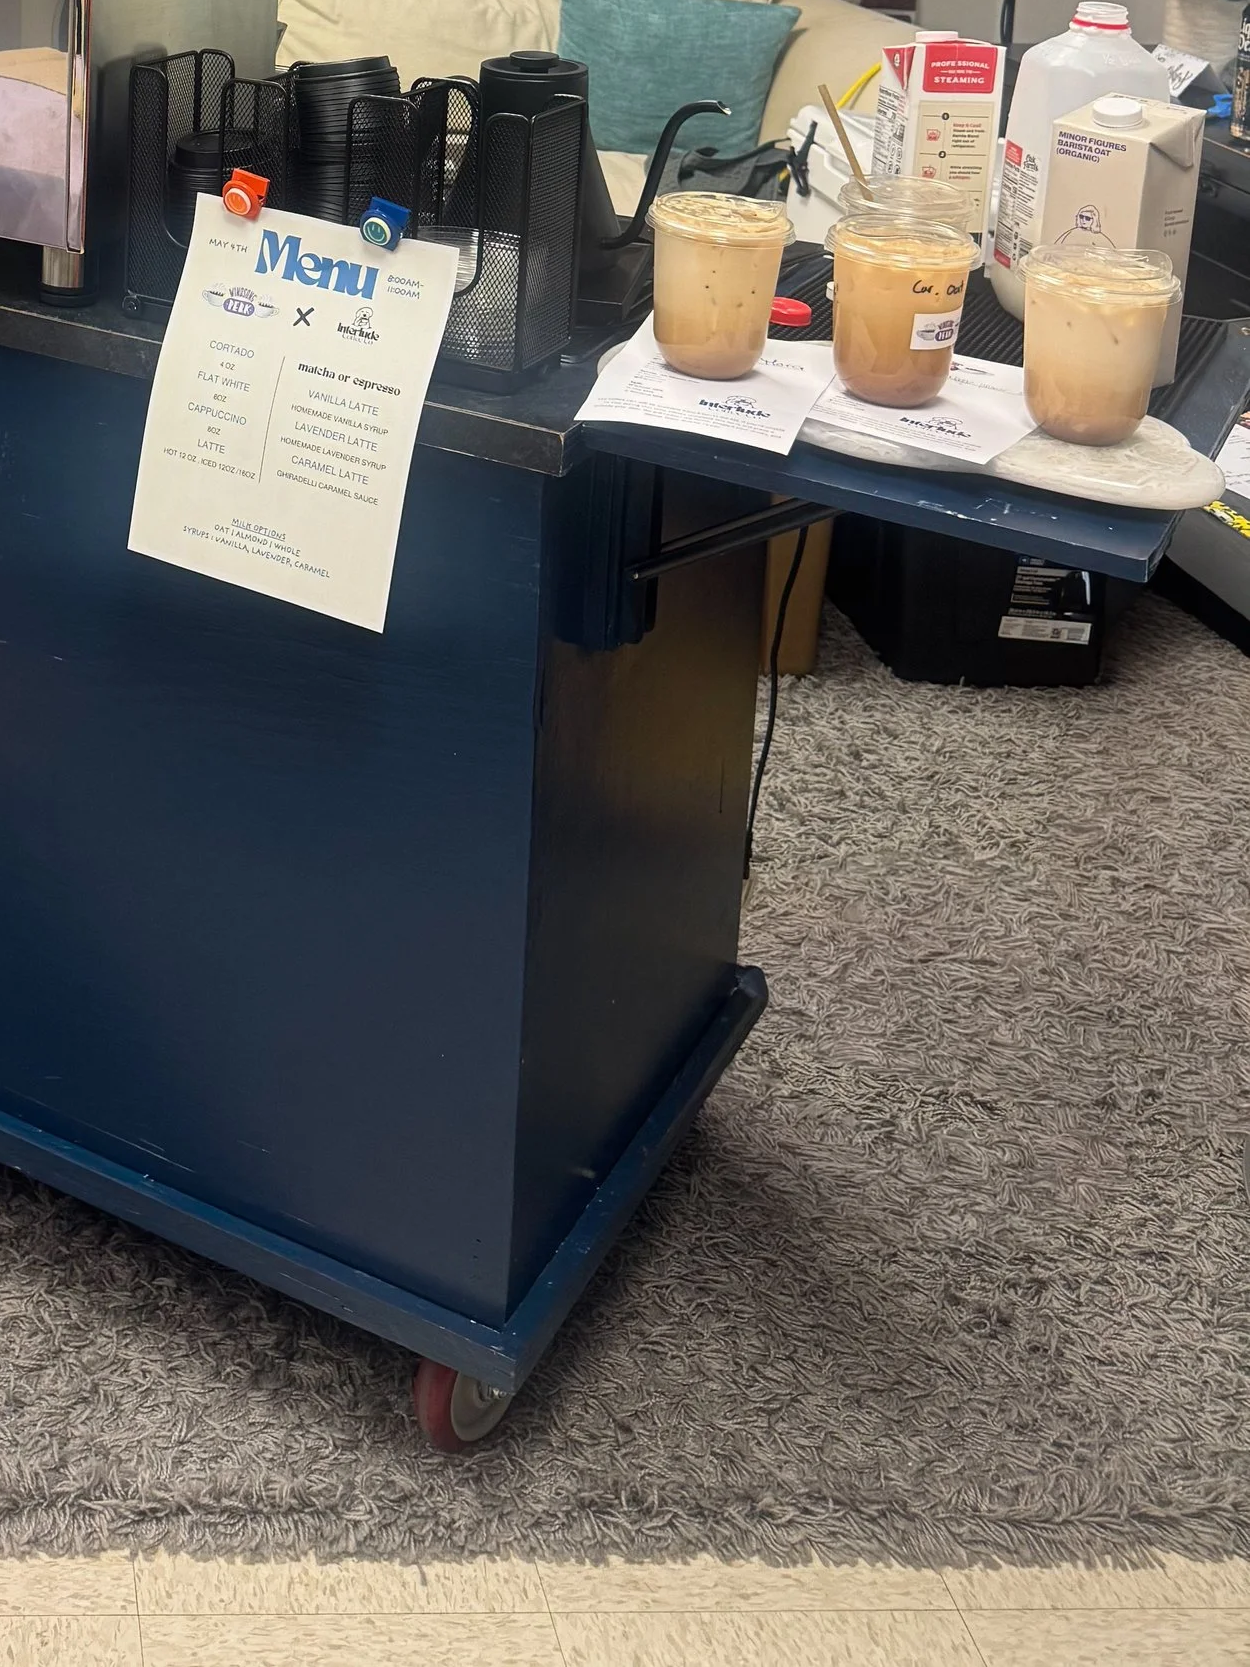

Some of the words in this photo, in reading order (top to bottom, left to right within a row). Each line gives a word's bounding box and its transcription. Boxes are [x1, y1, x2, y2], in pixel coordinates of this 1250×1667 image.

[930, 60, 990, 70] PROFESSIONAL
[933, 76, 985, 84] STEAMING
[1057, 139, 1093, 153] BARISTA
[1094, 147, 1112, 157] OAT
[1058, 131, 1088, 143] MINOR
[1088, 137, 1127, 152] FIGURES
[1056, 147, 1100, 164] (ORGANIC)
[208, 238, 229, 249] MAY
[230, 243, 248, 253] 4TH
[254, 229, 380, 300] Menu
[337, 322, 380, 341] Interlude
[209, 340, 255, 359] CORTADO
[225, 362, 236, 371] OZ
[197, 370, 220, 384] FLAT
[221, 377, 251, 392] WHITE
[297, 362, 335, 380] matcha
[337, 372, 351, 383] or
[352, 376, 401, 397] espresso
[187, 402, 247, 426] CAPPUCCINO
[308, 389, 347, 408] VANILLA
[348, 400, 380, 417] LATTE
[291, 403, 332, 421] HOMEMADE
[333, 415, 362, 430] VANILLA
[363, 423, 389, 436] SYRUP
[197, 438, 226, 455] LATTE
[294, 421, 346, 443] LAVENDER
[347, 435, 379, 453] LATTE
[163, 446, 178, 456] HOT
[200, 458, 217, 468] ICED
[280, 436, 321, 454] HOMEMADE
[322, 447, 361, 465] LAVENDER
[361, 459, 387, 472] SYRUP
[291, 455, 337, 477] CARAMEL
[338, 468, 370, 486] LATTE
[276, 469, 318, 488] GHIRADELLI
[318, 482, 352, 498] CARAMEL
[353, 492, 379, 506] SAUCE
[232, 518, 252, 531] MILK
[253, 524, 286, 541] OPTIONS
[183, 525, 209, 539] SYRUPS
[294, 560, 330, 579] CARAMEL
[214, 524, 230, 535] OAT
[236, 530, 268, 548] ALMOND
[274, 542, 301, 558] WHOLE
